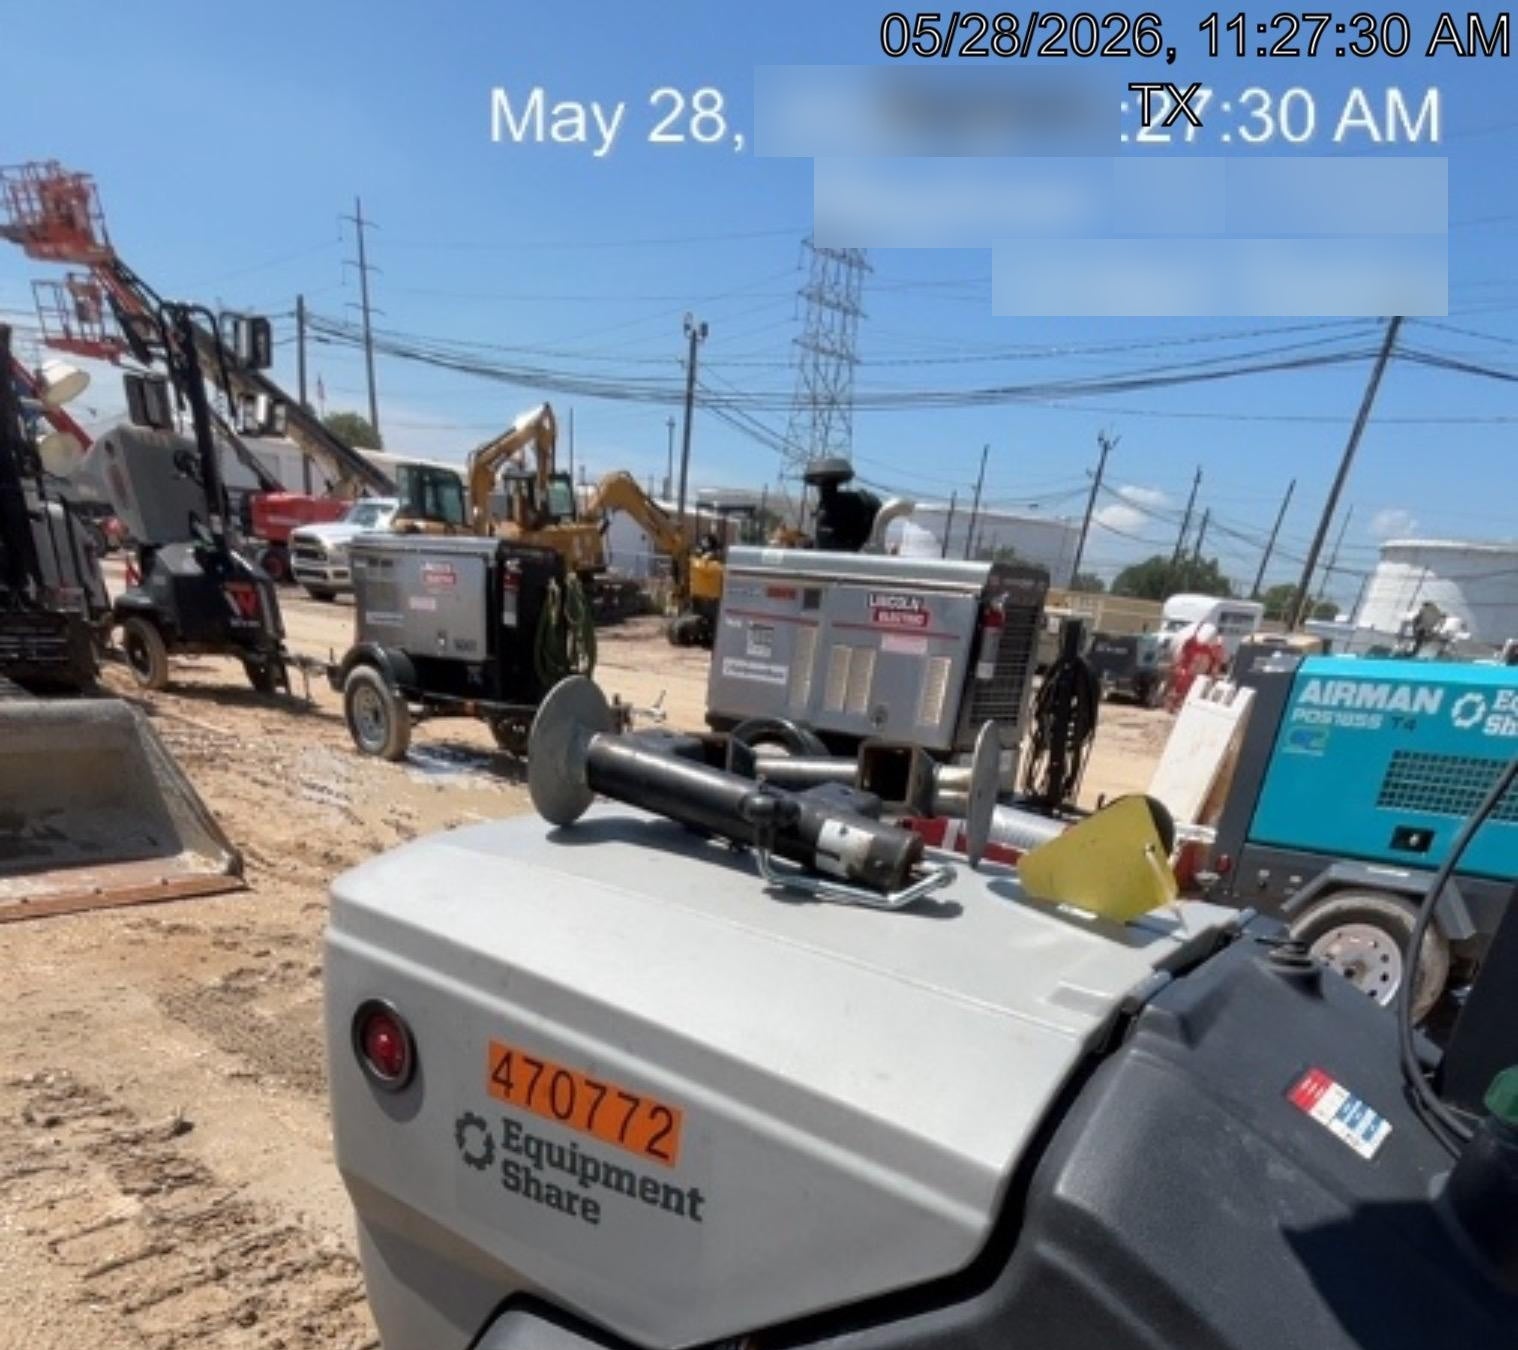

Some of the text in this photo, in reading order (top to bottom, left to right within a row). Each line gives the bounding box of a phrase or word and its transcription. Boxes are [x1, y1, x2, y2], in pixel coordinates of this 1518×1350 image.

[1298, 678, 1445, 715] AIRMAN
[491, 1050, 674, 1161] 470772
[502, 1116, 706, 1222] Equipment
[502, 1158, 601, 1225] Share
